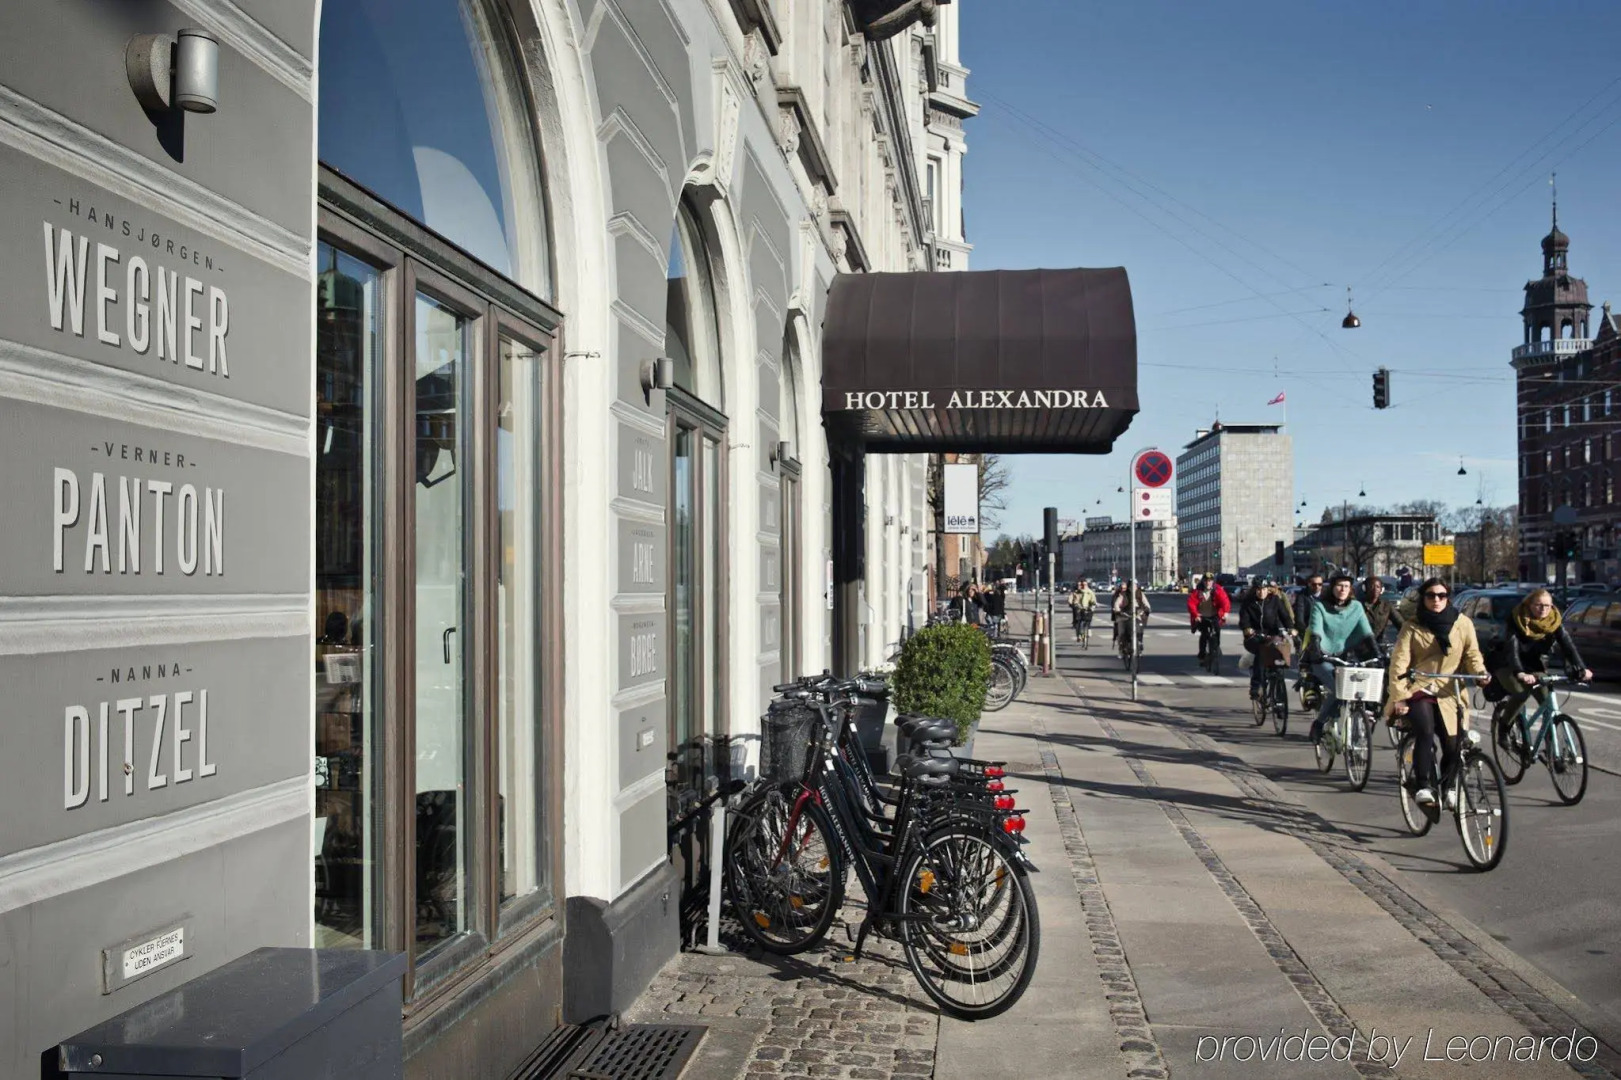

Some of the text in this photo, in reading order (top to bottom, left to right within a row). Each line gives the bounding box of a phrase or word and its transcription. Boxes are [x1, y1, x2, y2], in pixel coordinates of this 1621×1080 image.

[43, 219, 230, 379] WEGNER
[844, 389, 1109, 410] HOTEL ALEXANDRA
[633, 449, 653, 493] JALK
[53, 467, 224, 576] PANTON
[633, 542, 654, 584] ARNE
[64, 688, 217, 811] DITZEL
[818, 785, 834, 812] HOTEL
[830, 813, 857, 867] ALEXANDRA
[129, 943, 155, 960] CYKLER
